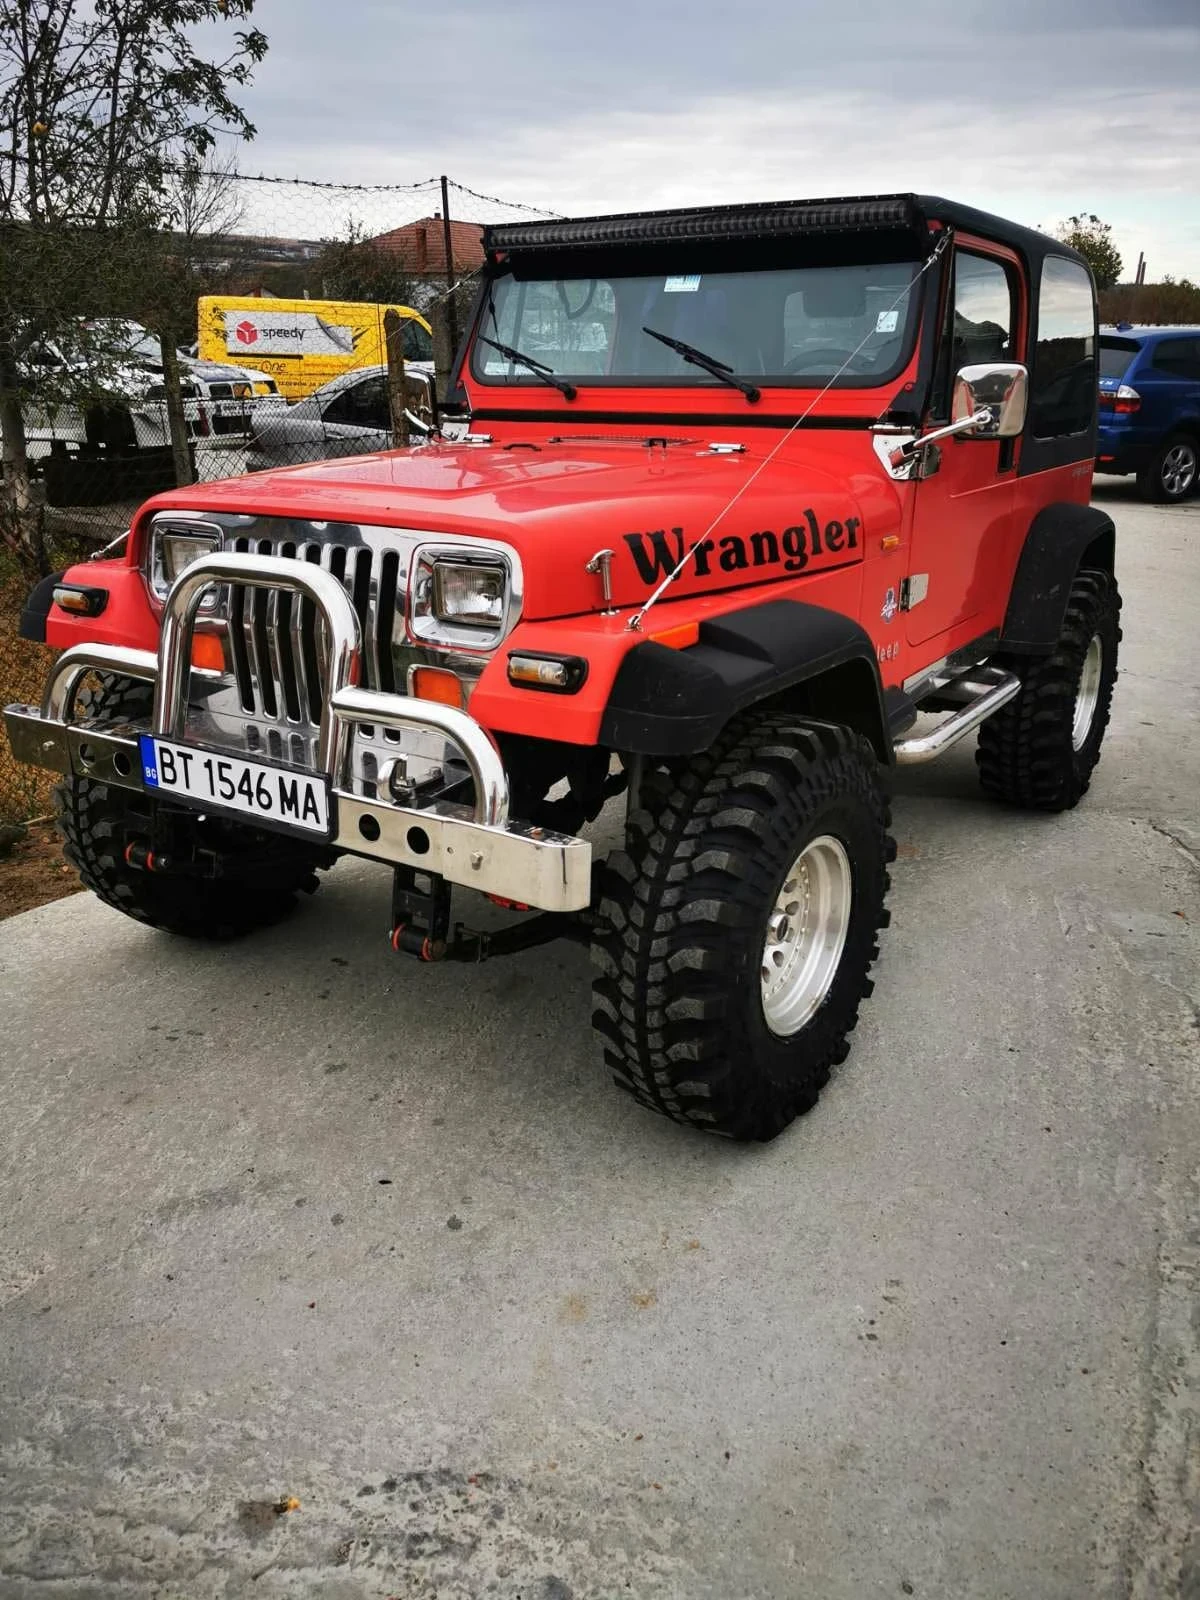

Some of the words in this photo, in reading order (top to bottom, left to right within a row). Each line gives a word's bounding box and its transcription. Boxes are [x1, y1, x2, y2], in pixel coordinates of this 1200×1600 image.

[262, 326, 305, 341] speedy
[623, 508, 861, 585] Wrangler
[145, 767, 157, 780] BG
[159, 746, 194, 790] BT
[203, 758, 273, 811] 1546
[278, 775, 321, 825] MA
